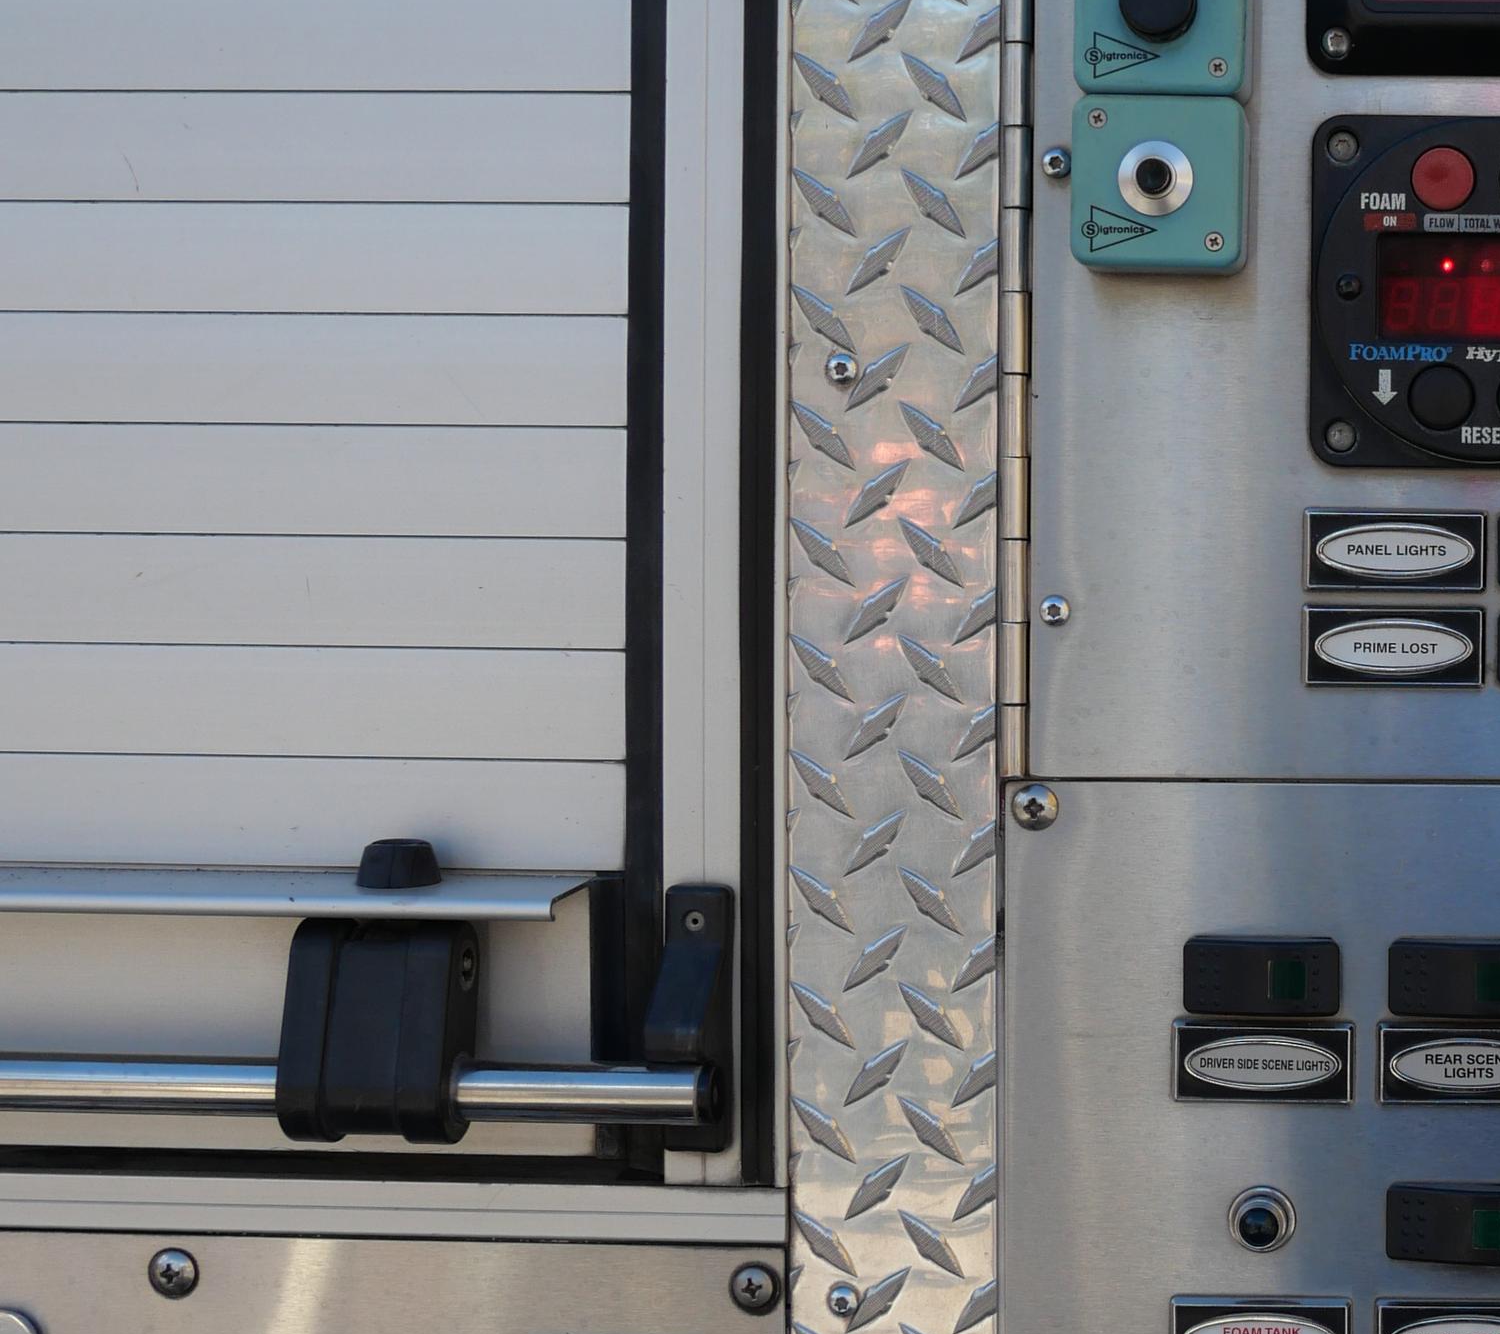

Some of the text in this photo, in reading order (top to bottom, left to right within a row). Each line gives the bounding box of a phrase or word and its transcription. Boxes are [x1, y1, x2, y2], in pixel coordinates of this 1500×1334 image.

[1087, 49, 1148, 63] Sigtronics
[1360, 192, 1406, 211] FOAM
[1383, 215, 1398, 227] ON
[1428, 218, 1455, 229] FLOW
[1464, 218, 1490, 229] TOTAL
[1084, 223, 1145, 236] Sigtronics
[1347, 544, 1447, 557] PANEL LIGHTS
[1353, 642, 1438, 655] PRIME LOST
[1200, 1057, 1330, 1072] DRIVER SIDE SCENE LIGHTS
[1425, 1054, 1462, 1065] REAR
[1444, 1068, 1494, 1078] LIGHTS
